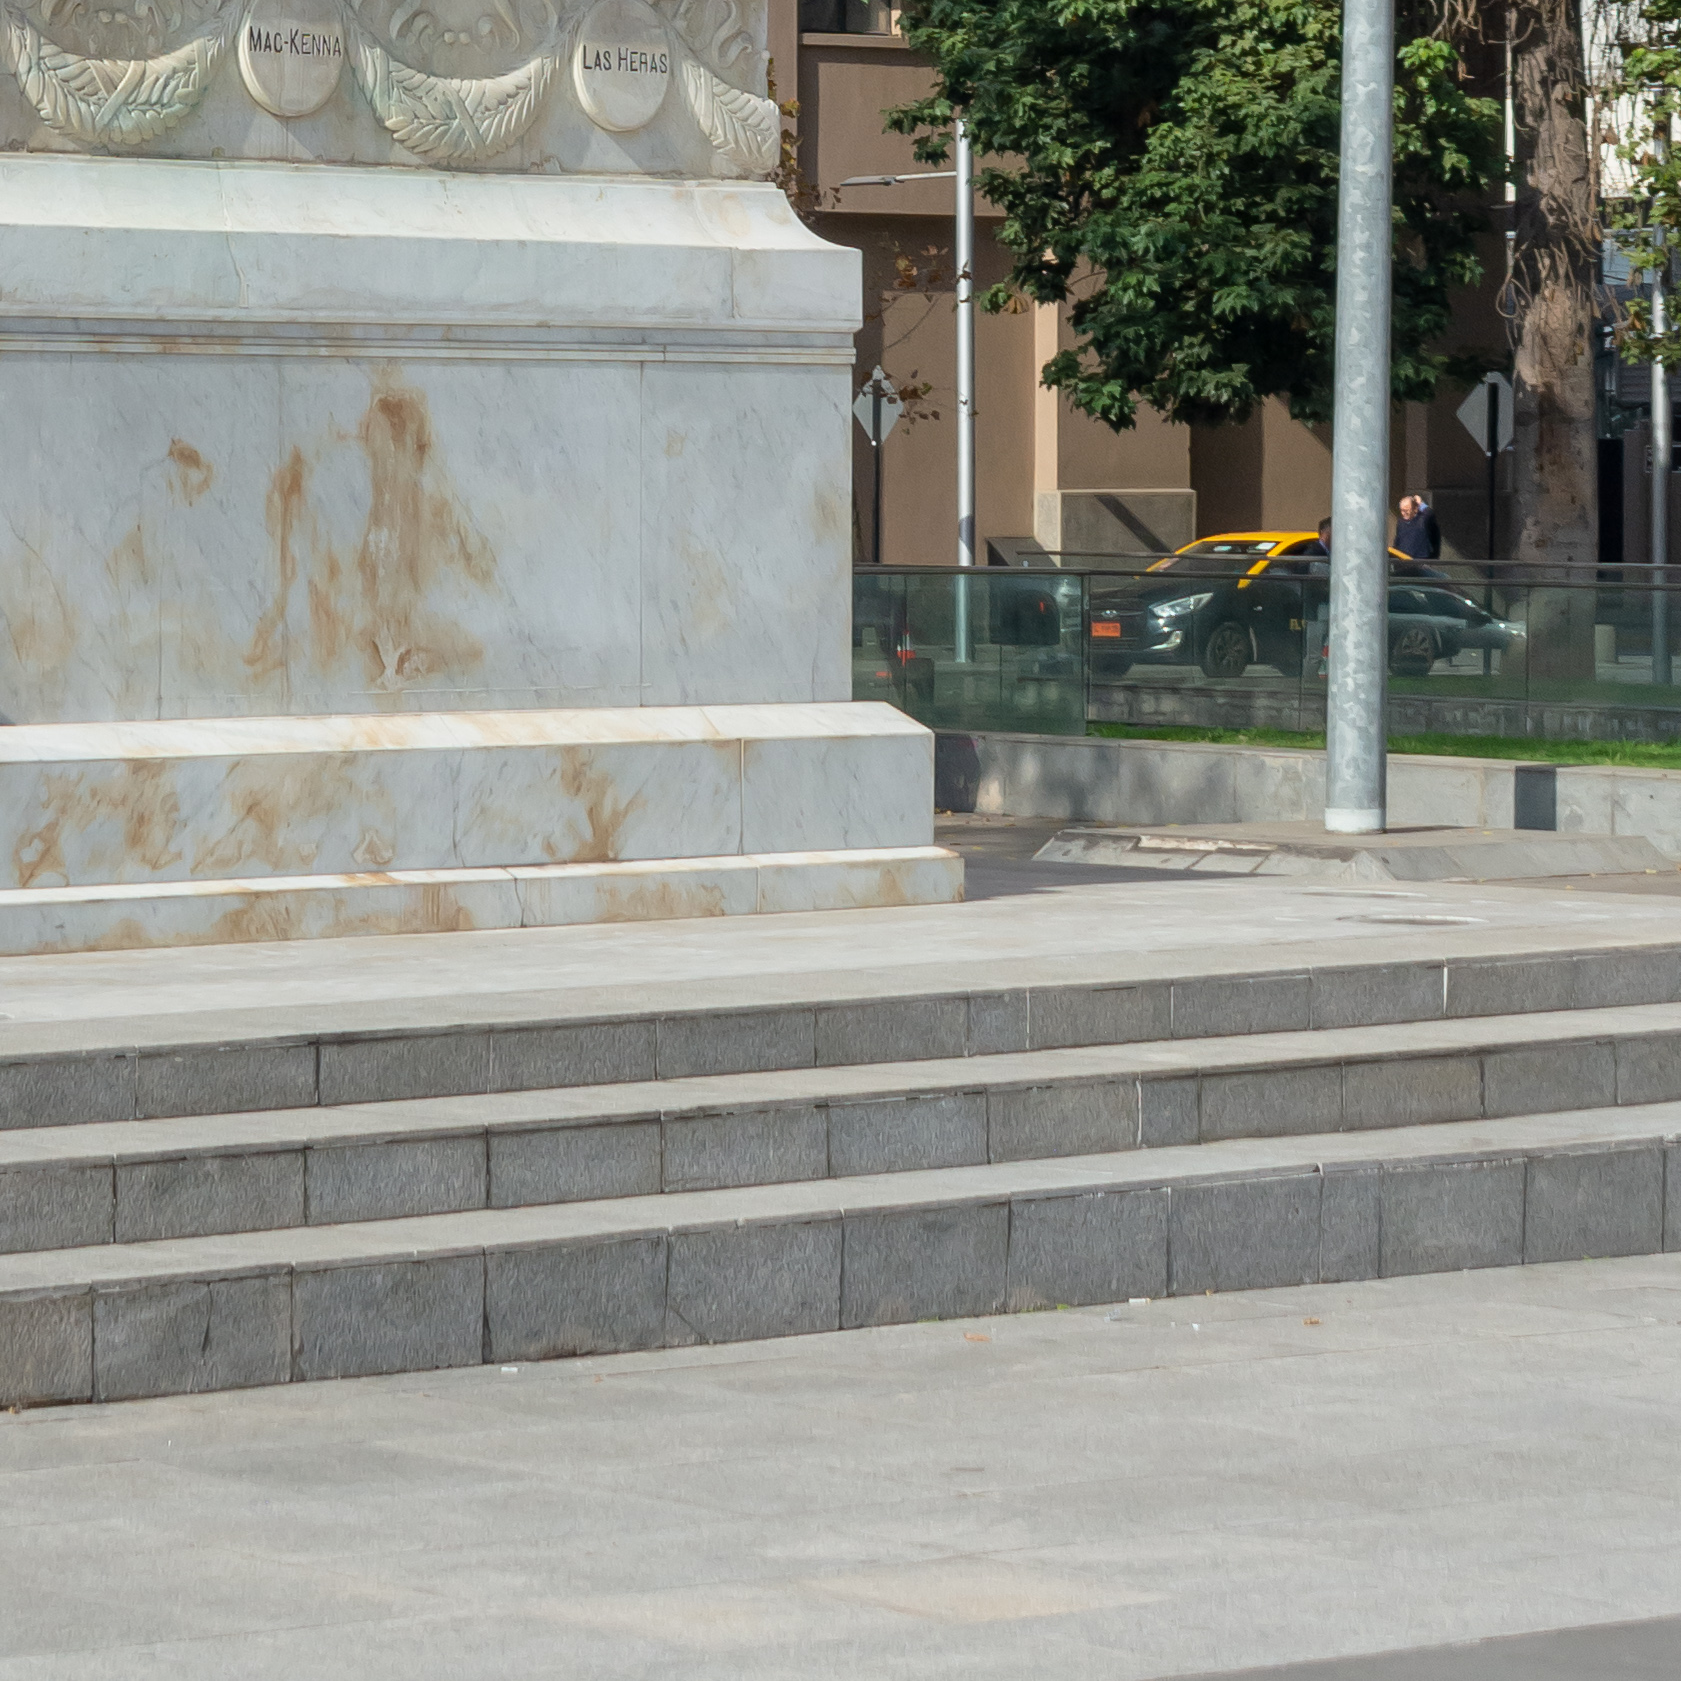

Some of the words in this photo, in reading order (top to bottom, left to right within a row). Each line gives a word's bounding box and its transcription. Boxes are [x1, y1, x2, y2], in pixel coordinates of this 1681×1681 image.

[249, 25, 342, 58] MAC-KENNA
[583, 44, 612, 71] LAS
[617, 47, 668, 73] HERAS
